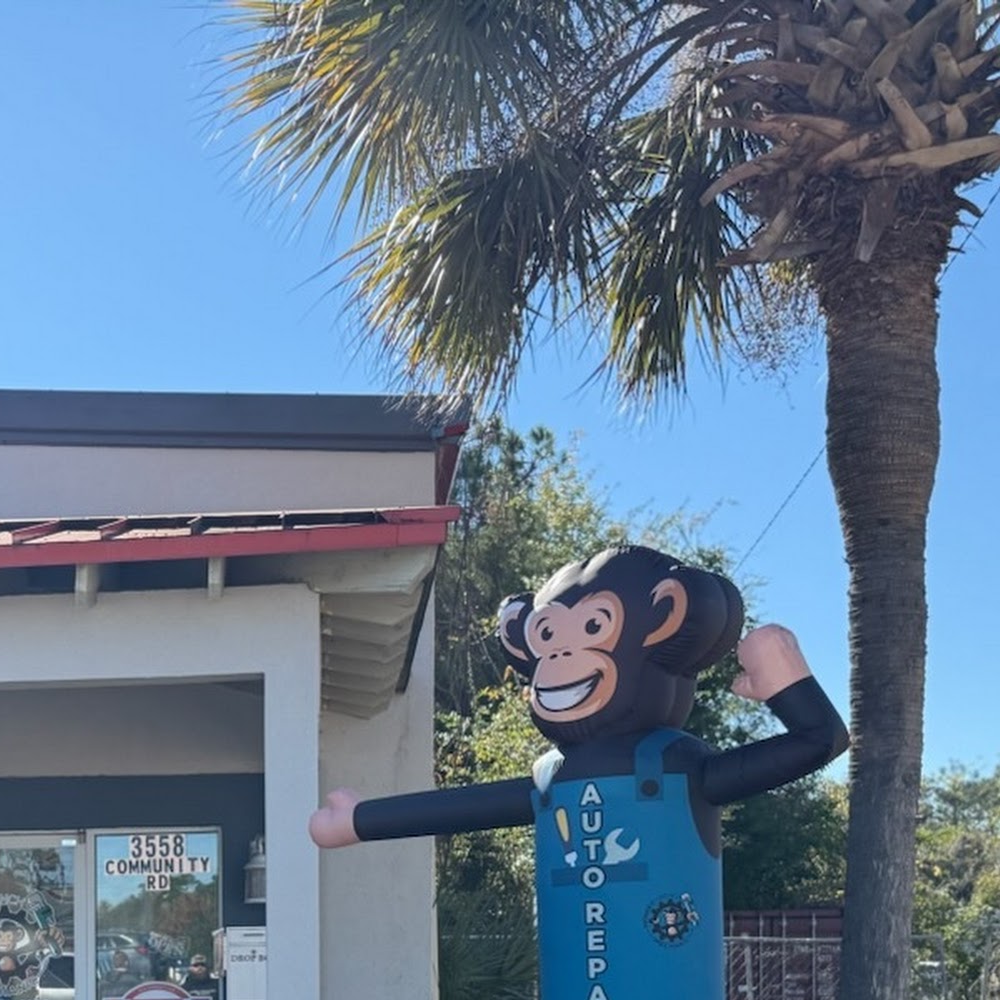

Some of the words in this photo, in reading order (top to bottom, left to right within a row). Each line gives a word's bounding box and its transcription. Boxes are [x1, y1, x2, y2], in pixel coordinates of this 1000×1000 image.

[579, 782, 606, 889] AUTO
[131, 835, 184, 858] 3558
[105, 857, 210, 875] COMMUNITY
[147, 875, 168, 889] RD
